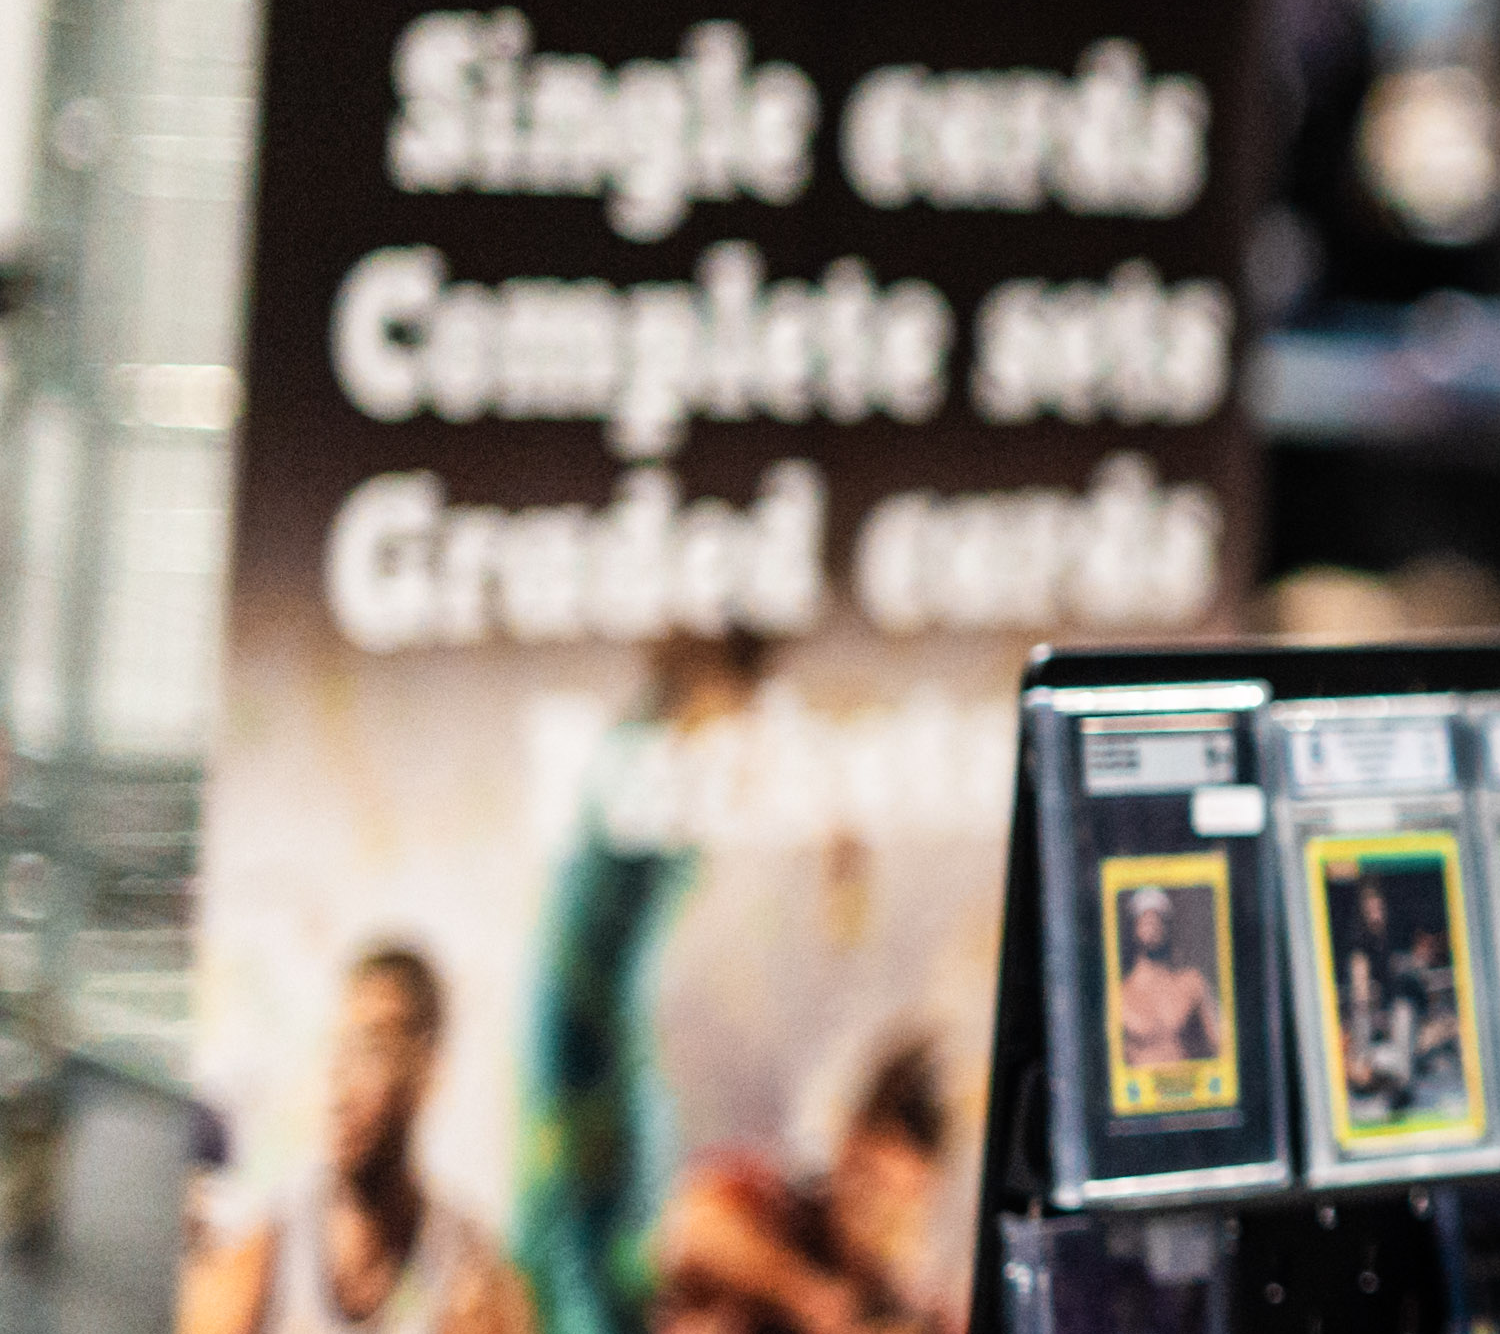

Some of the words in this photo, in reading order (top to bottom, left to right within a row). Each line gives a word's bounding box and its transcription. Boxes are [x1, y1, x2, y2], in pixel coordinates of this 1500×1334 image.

[388, 5, 818, 241] Single
[842, 37, 1209, 218] cards
[330, 241, 954, 459] Complete
[970, 261, 1236, 424] sets
[326, 461, 826, 651] Graded
[854, 455, 1220, 633] cards
